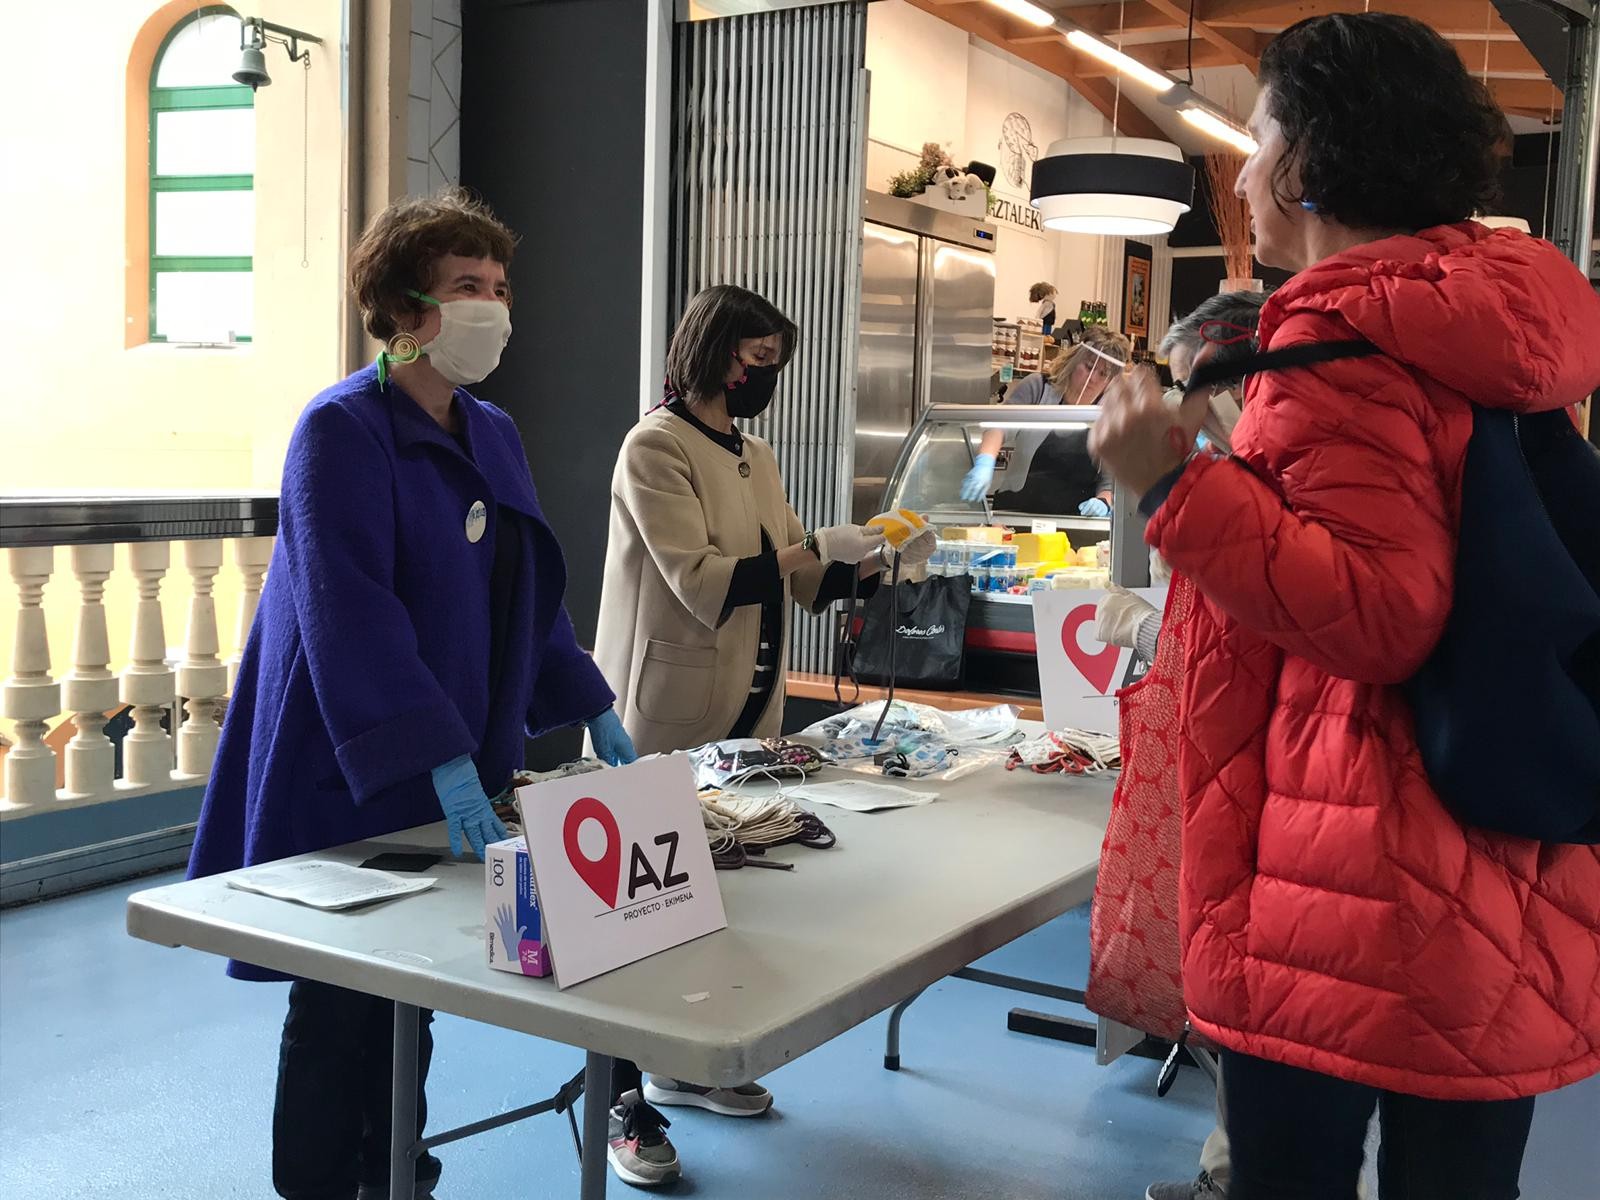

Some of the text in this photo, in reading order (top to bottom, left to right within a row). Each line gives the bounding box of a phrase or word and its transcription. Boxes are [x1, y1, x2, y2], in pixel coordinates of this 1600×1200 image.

[493, 857, 504, 886] 100
[627, 831, 689, 899] AZ
[623, 892, 694, 921] PROYECTO EKIMENA
[528, 949, 538, 965] M
